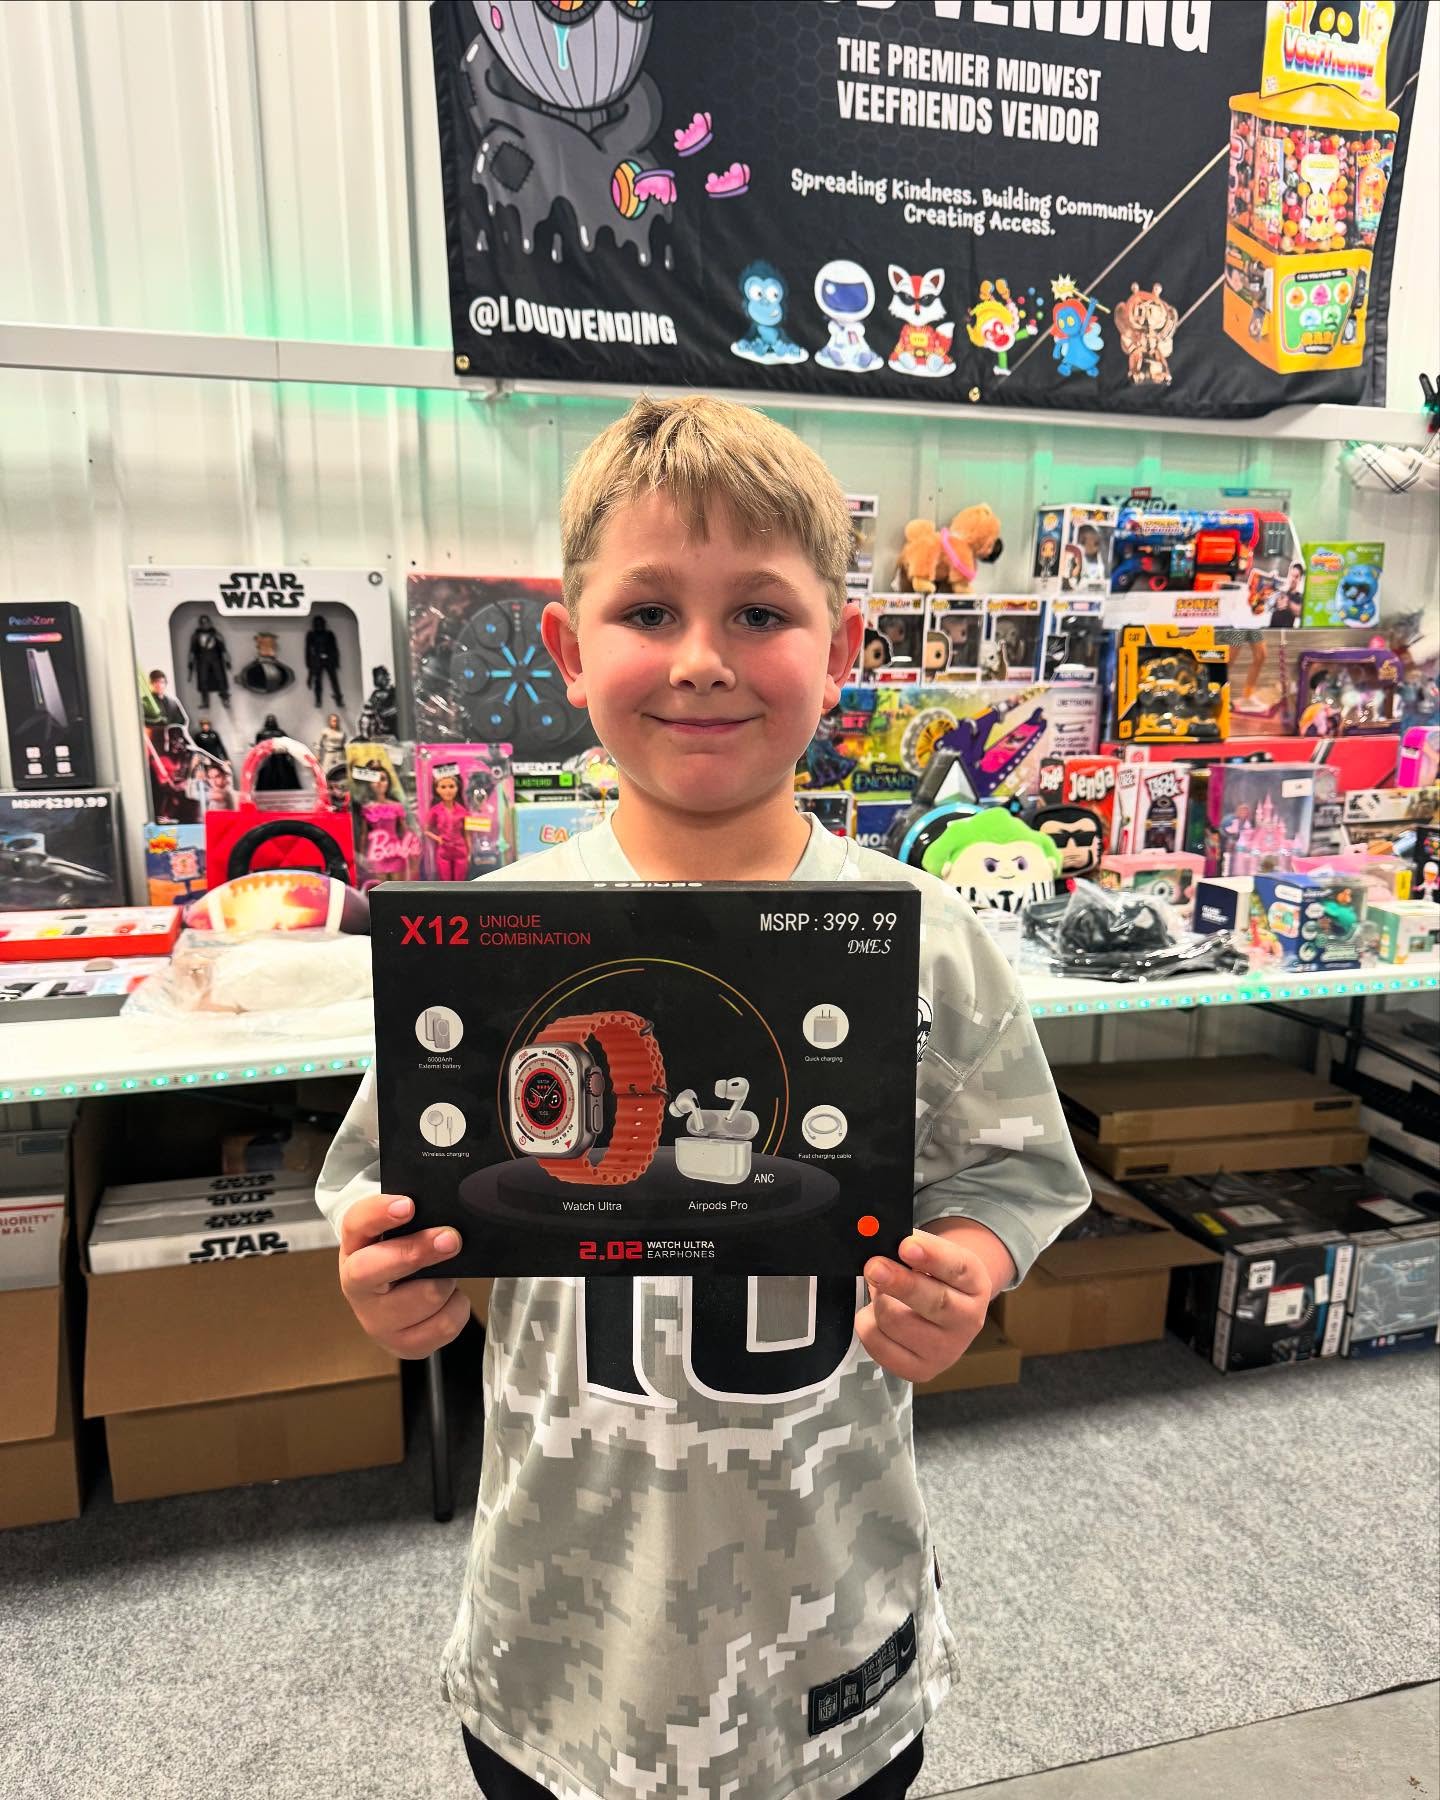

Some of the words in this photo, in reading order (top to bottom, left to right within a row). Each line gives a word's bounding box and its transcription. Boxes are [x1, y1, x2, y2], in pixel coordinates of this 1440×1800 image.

[837, 37, 880, 75] THE
[888, 43, 990, 88] PREMIER
[996, 57, 1101, 101] MIDWEST
[837, 80, 993, 135] VEEFRIENDS
[1000, 99, 1099, 147] VENDOR
[791, 168, 888, 204] Spreading
[892, 178, 977, 206] Kindness.
[982, 186, 1051, 219] Building
[904, 203, 985, 235] Creating
[989, 211, 1056, 236] Access.
[469, 296, 678, 346] @LOUDVENDING
[219, 572, 304, 590] STAR
[220, 591, 305, 608] WARS
[1068, 764, 1115, 802] Jenga
[368, 829, 421, 861] Barbie
[400, 915, 469, 945] X12
[479, 915, 541, 929] UNIQUE
[479, 932, 591, 945] COMBINATION
[847, 938, 892, 954] DMES
[821, 1055, 843, 1063] charging
[811, 1153, 835, 1161] charging
[753, 1172, 775, 1184] ANC
[562, 1201, 595, 1212] Watch
[598, 1201, 622, 1212] Ultra
[688, 1200, 727, 1212] Airpods
[730, 1201, 748, 1211] Pro
[189, 1231, 289, 1258] STAR
[579, 1241, 643, 1261] 2.02
[647, 1241, 681, 1249] WATCH
[683, 1241, 715, 1249] ULTRA
[647, 1250, 715, 1259] EARPHONES
